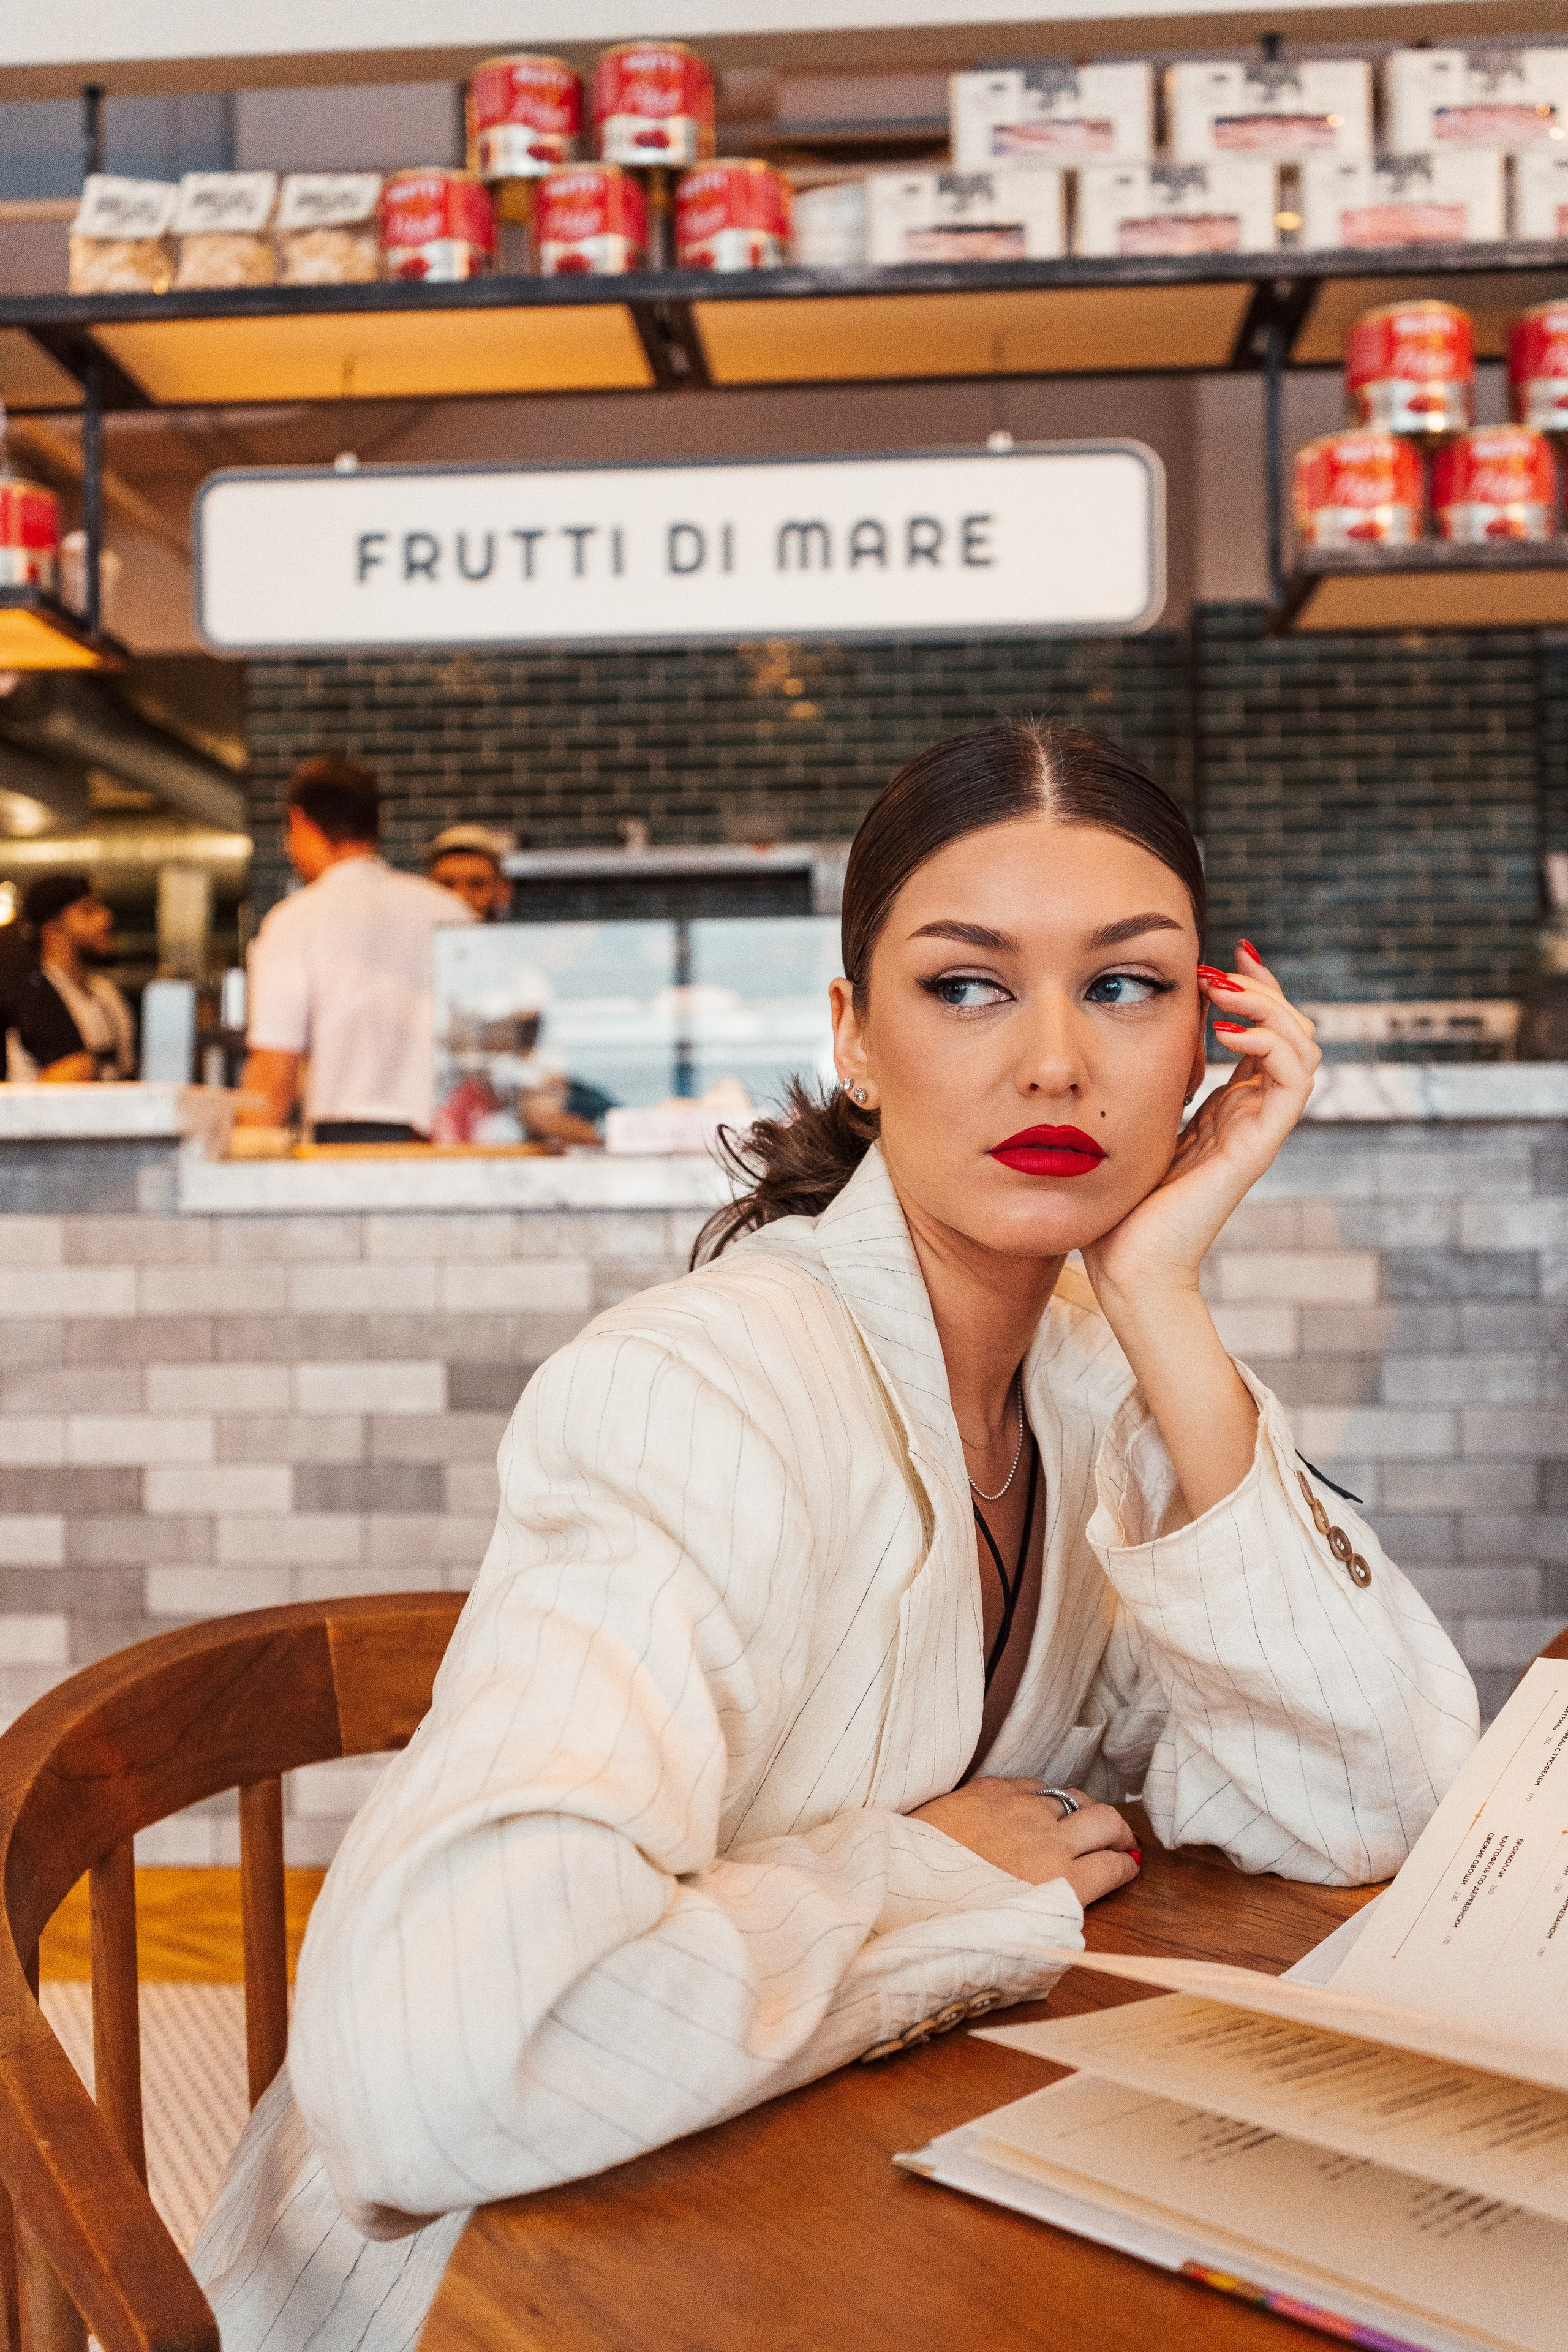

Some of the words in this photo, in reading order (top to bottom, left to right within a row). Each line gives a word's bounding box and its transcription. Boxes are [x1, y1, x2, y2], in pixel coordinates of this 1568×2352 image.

[356, 527, 623, 582] FRUTTI
[668, 522, 733, 575] DI
[777, 513, 994, 569] MARE
[1552, 1713, 1567, 1731] ГРИЛЬ
[1544, 1736, 1553, 1746] 290
[1557, 1729, 1568, 1747] ФЕЛЬ
[1534, 1752, 1559, 1787] ТРЮФЕЛЕМ
[1525, 1792, 1535, 1802] 170
[1476, 1832, 1494, 1859] СВЕЖИЕ
[1483, 1834, 1509, 1874] КАРТОФЕЛЬ
[1498, 1838, 1524, 1878] БРОККОЛЛИ
[1460, 1860, 1479, 1885] ОВОЩИ
[1450, 1891, 1461, 1902] 230
[1488, 1884, 1498, 1895] 260
[1553, 1883, 1562, 1893] 130
[1452, 1874, 1487, 1928] ПО-ДЕРЕВЕНСКИ
[1442, 1935, 1452, 1945] 170
